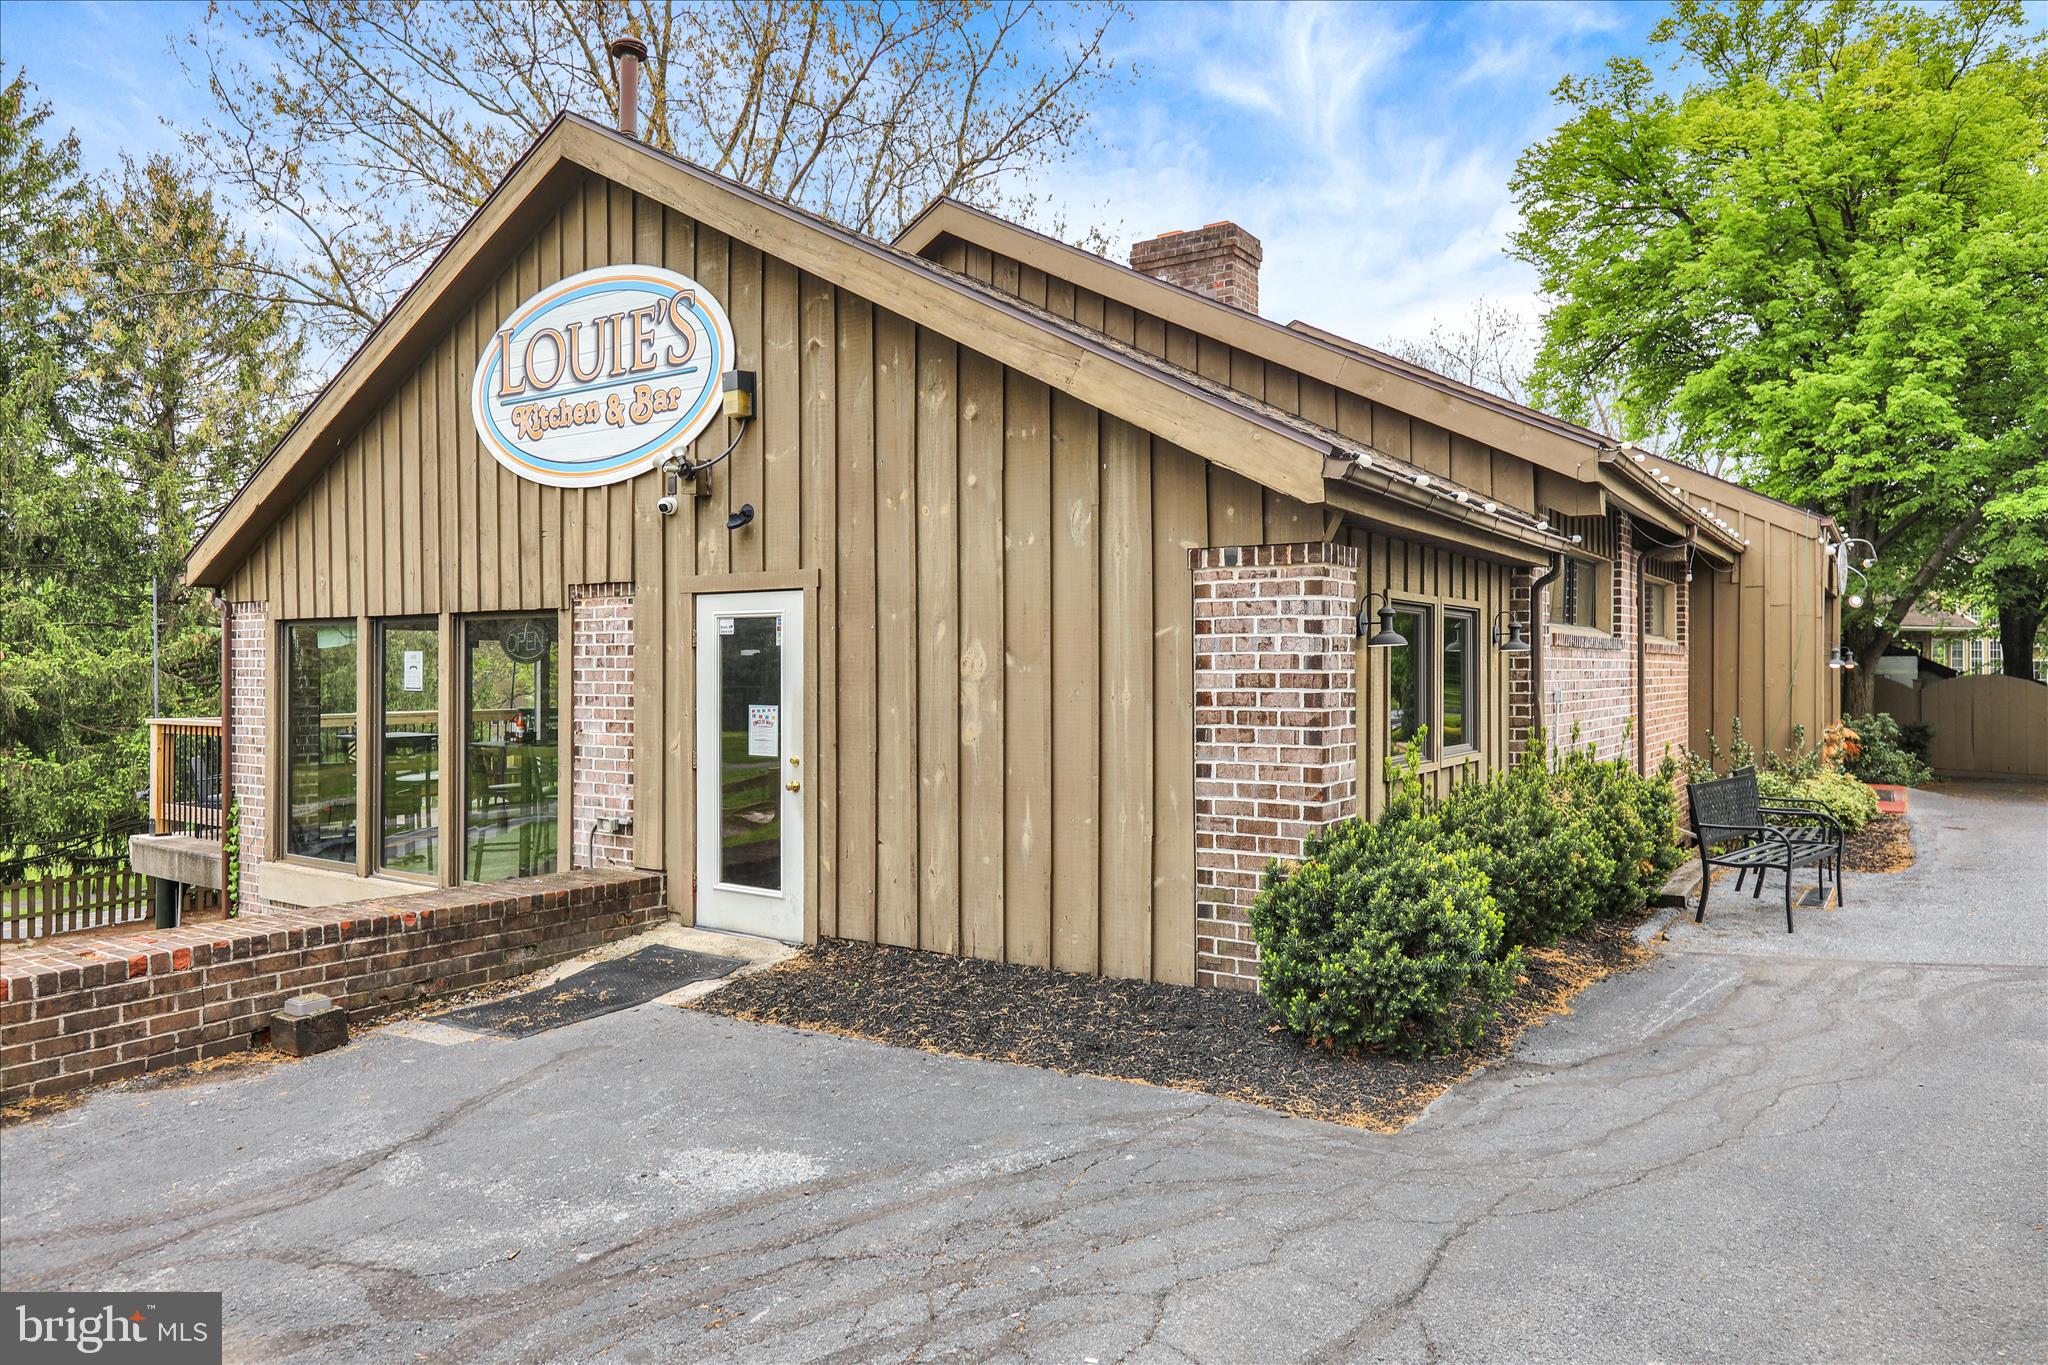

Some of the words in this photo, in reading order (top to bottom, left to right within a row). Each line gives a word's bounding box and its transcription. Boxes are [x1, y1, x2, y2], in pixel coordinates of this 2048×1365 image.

[498, 289, 697, 398] LOUIE'S
[512, 398, 600, 440] Kitchen
[606, 394, 625, 427] &
[630, 385, 681, 424] Bar
[507, 631, 544, 652] OPEN
